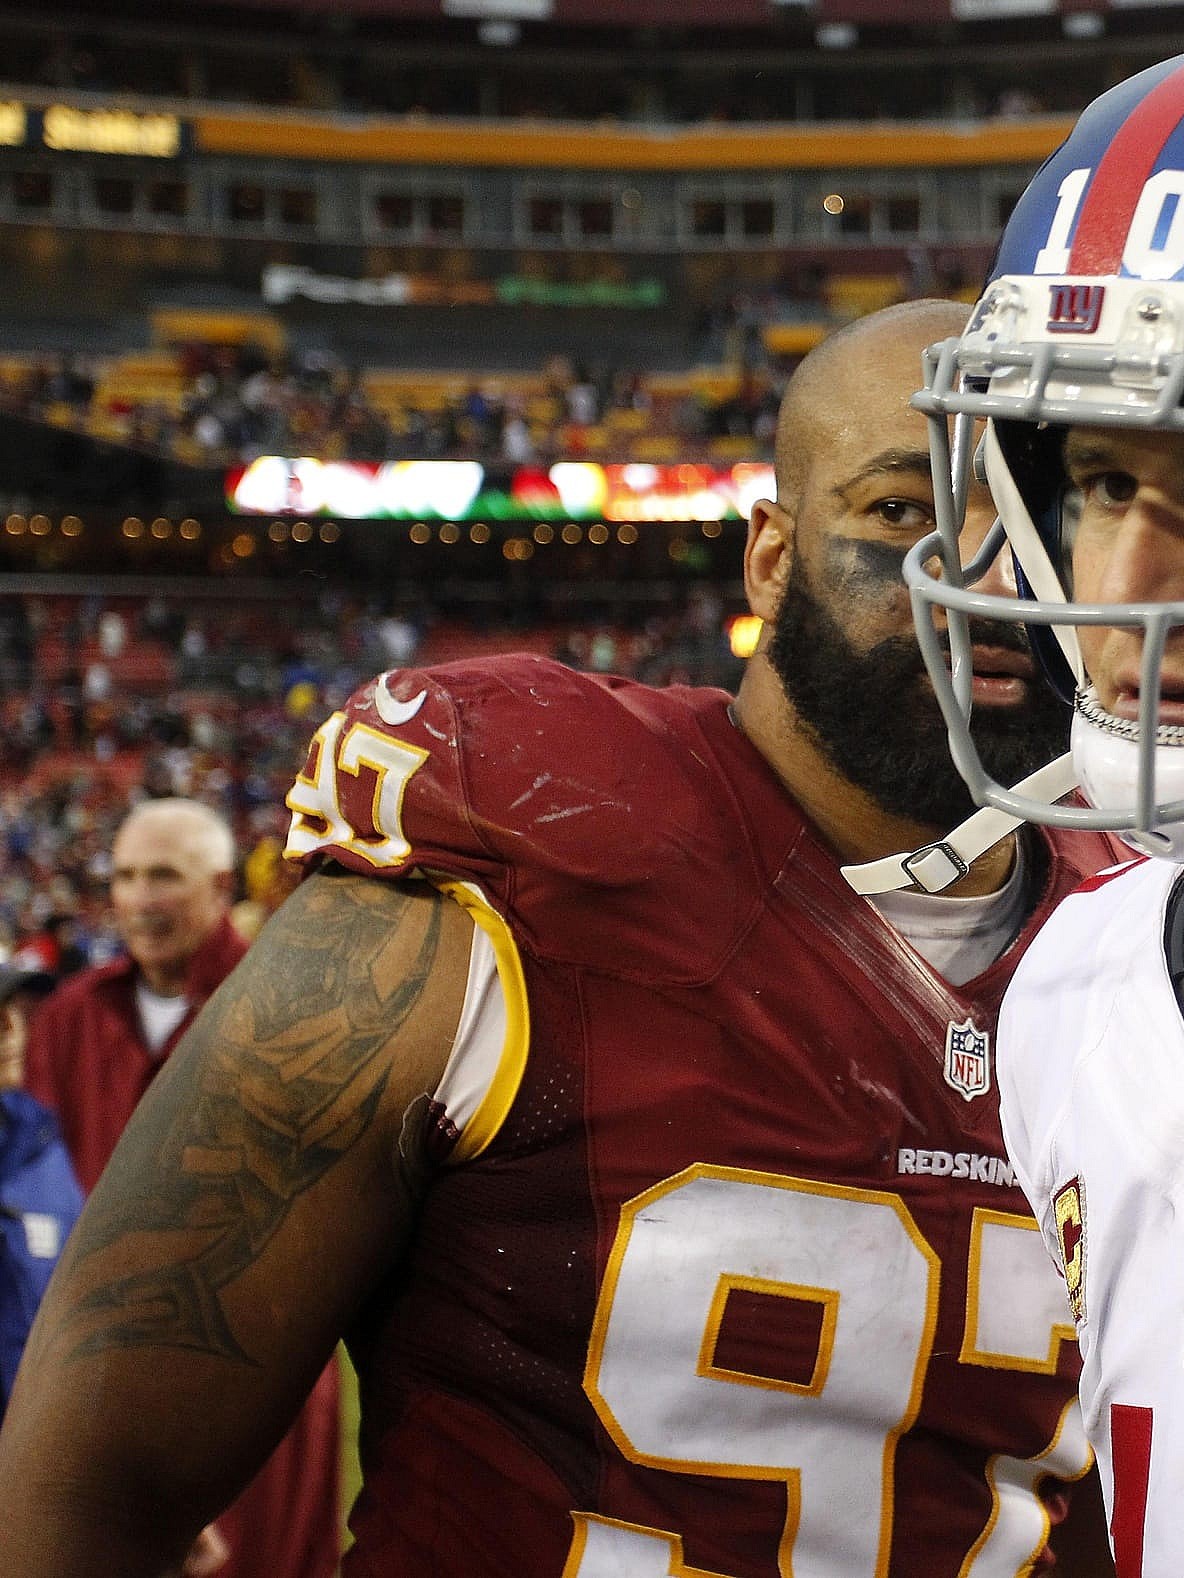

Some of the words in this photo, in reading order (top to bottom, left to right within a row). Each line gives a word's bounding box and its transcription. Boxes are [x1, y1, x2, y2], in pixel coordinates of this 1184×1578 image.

[282, 710, 431, 868] 97
[952, 1052, 983, 1087] NFL
[898, 1148, 1020, 1188] REDSKIN
